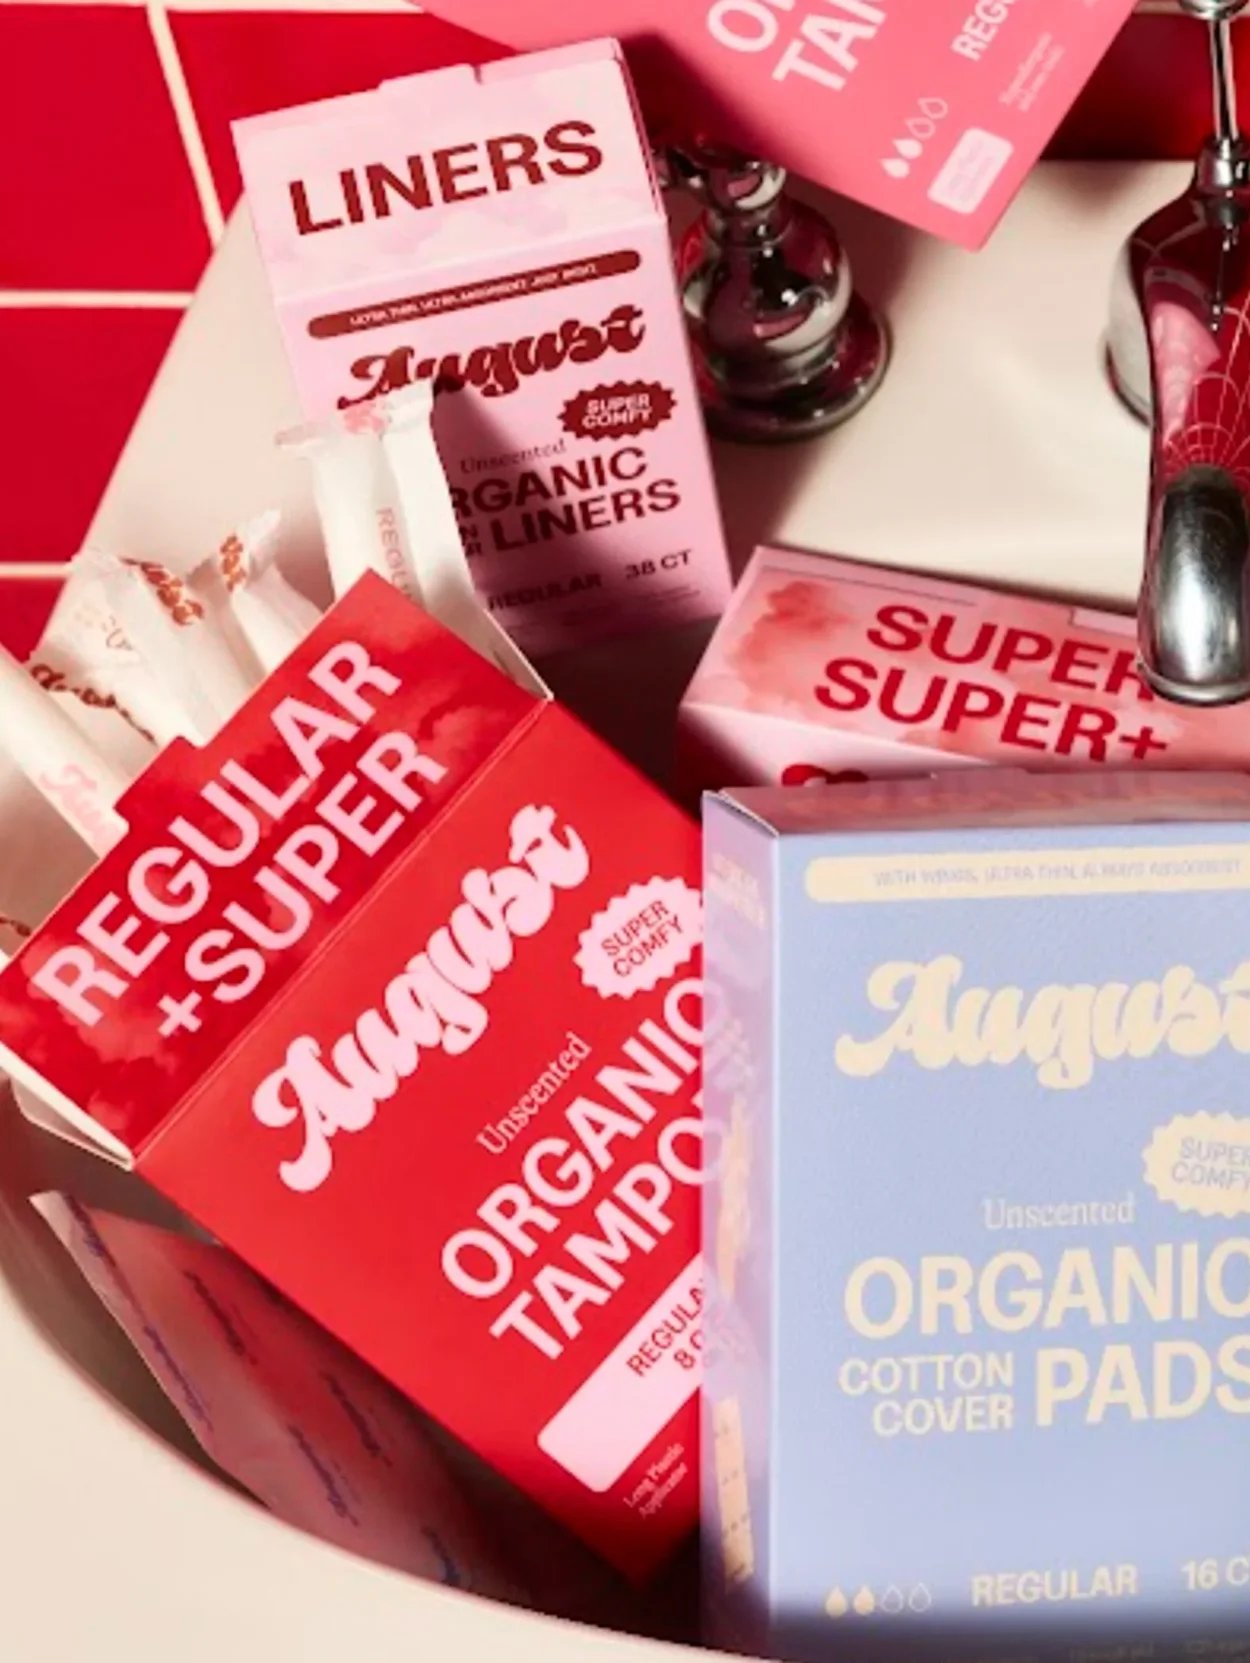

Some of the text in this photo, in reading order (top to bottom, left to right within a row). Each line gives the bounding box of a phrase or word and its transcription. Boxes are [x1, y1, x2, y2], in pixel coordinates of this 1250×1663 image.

[289, 120, 603, 236] LINERS
[336, 304, 646, 411] August
[581, 406, 653, 430] COMFY
[586, 393, 650, 417] SUPER
[450, 446, 648, 518] RGANIC
[460, 438, 567, 476] Unscented
[490, 478, 681, 552] LINERS
[625, 560, 658, 580] 38
[659, 548, 692, 570] CT
[866, 604, 1157, 702] SUPER
[813, 658, 1170, 762] SUPER+
[31, 639, 402, 1027] REGULAR
[156, 729, 448, 1038] +SUPER
[600, 899, 671, 957] SUPER
[613, 914, 685, 978] COMFY
[250, 803, 590, 1192] August
[475, 1031, 592, 1155] Unscented
[982, 1193, 1136, 1230] Unscented
[838, 1352, 1014, 1396] COTTON
[872, 1396, 1014, 1437] COVER
[971, 1564, 1138, 1607] REGULAR
[1181, 1560, 1219, 1591] 16
